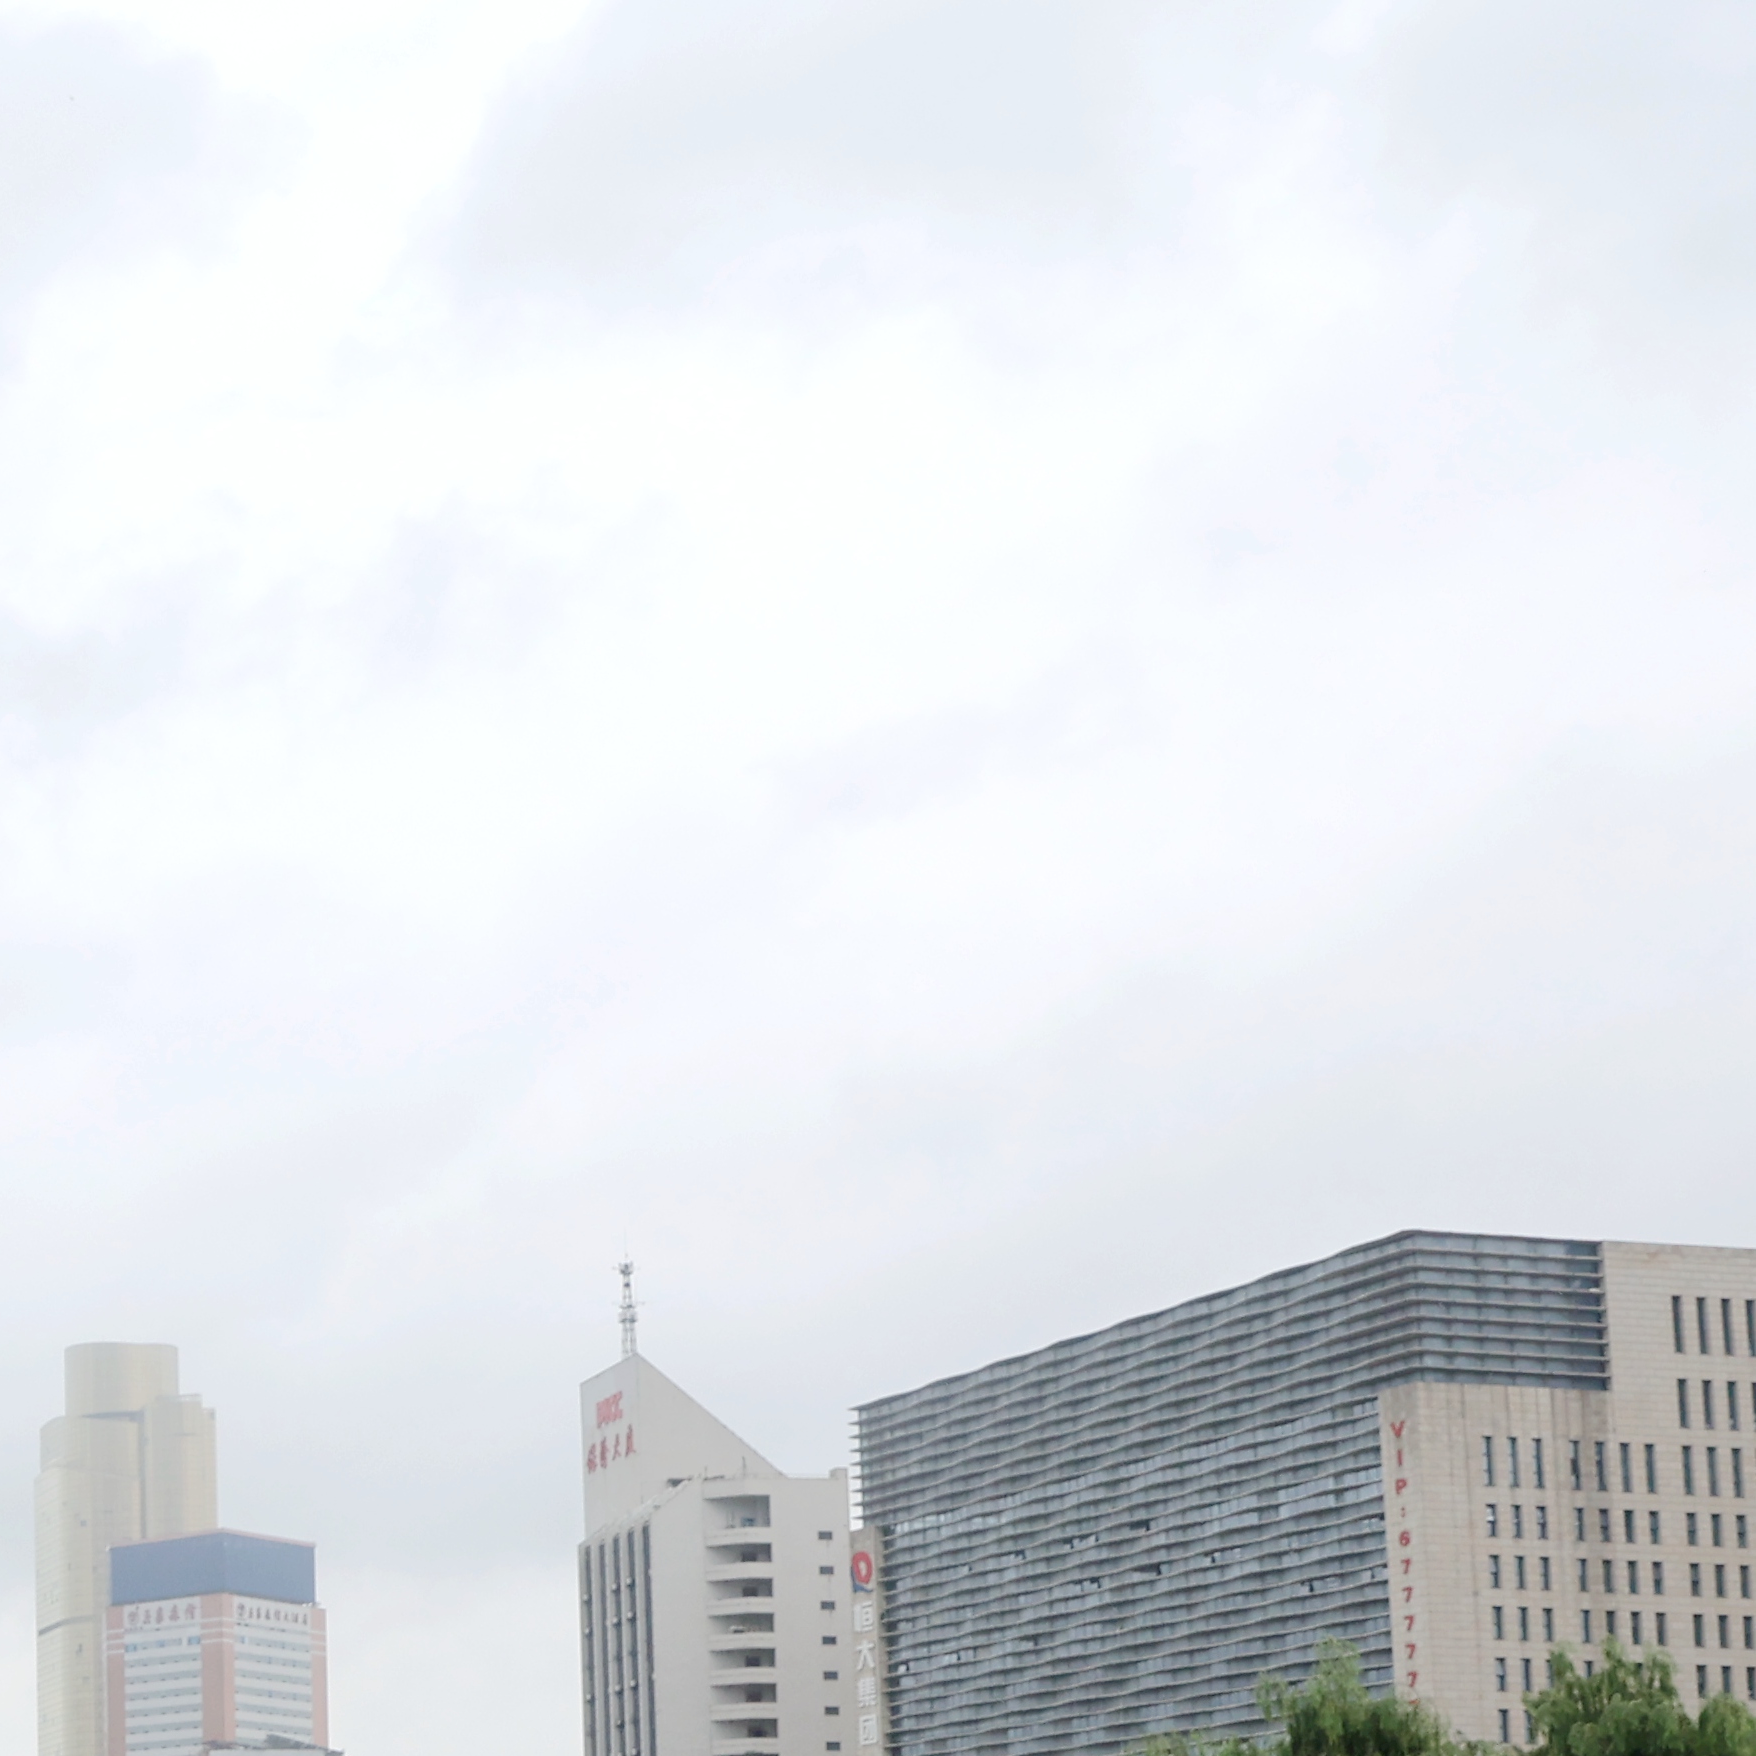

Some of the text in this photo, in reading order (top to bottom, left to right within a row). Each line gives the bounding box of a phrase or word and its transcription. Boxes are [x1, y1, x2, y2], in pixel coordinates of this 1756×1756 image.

[1390, 1421, 1421, 1704] VIP:677777
[853, 1602, 878, 1746] 恒大集团
